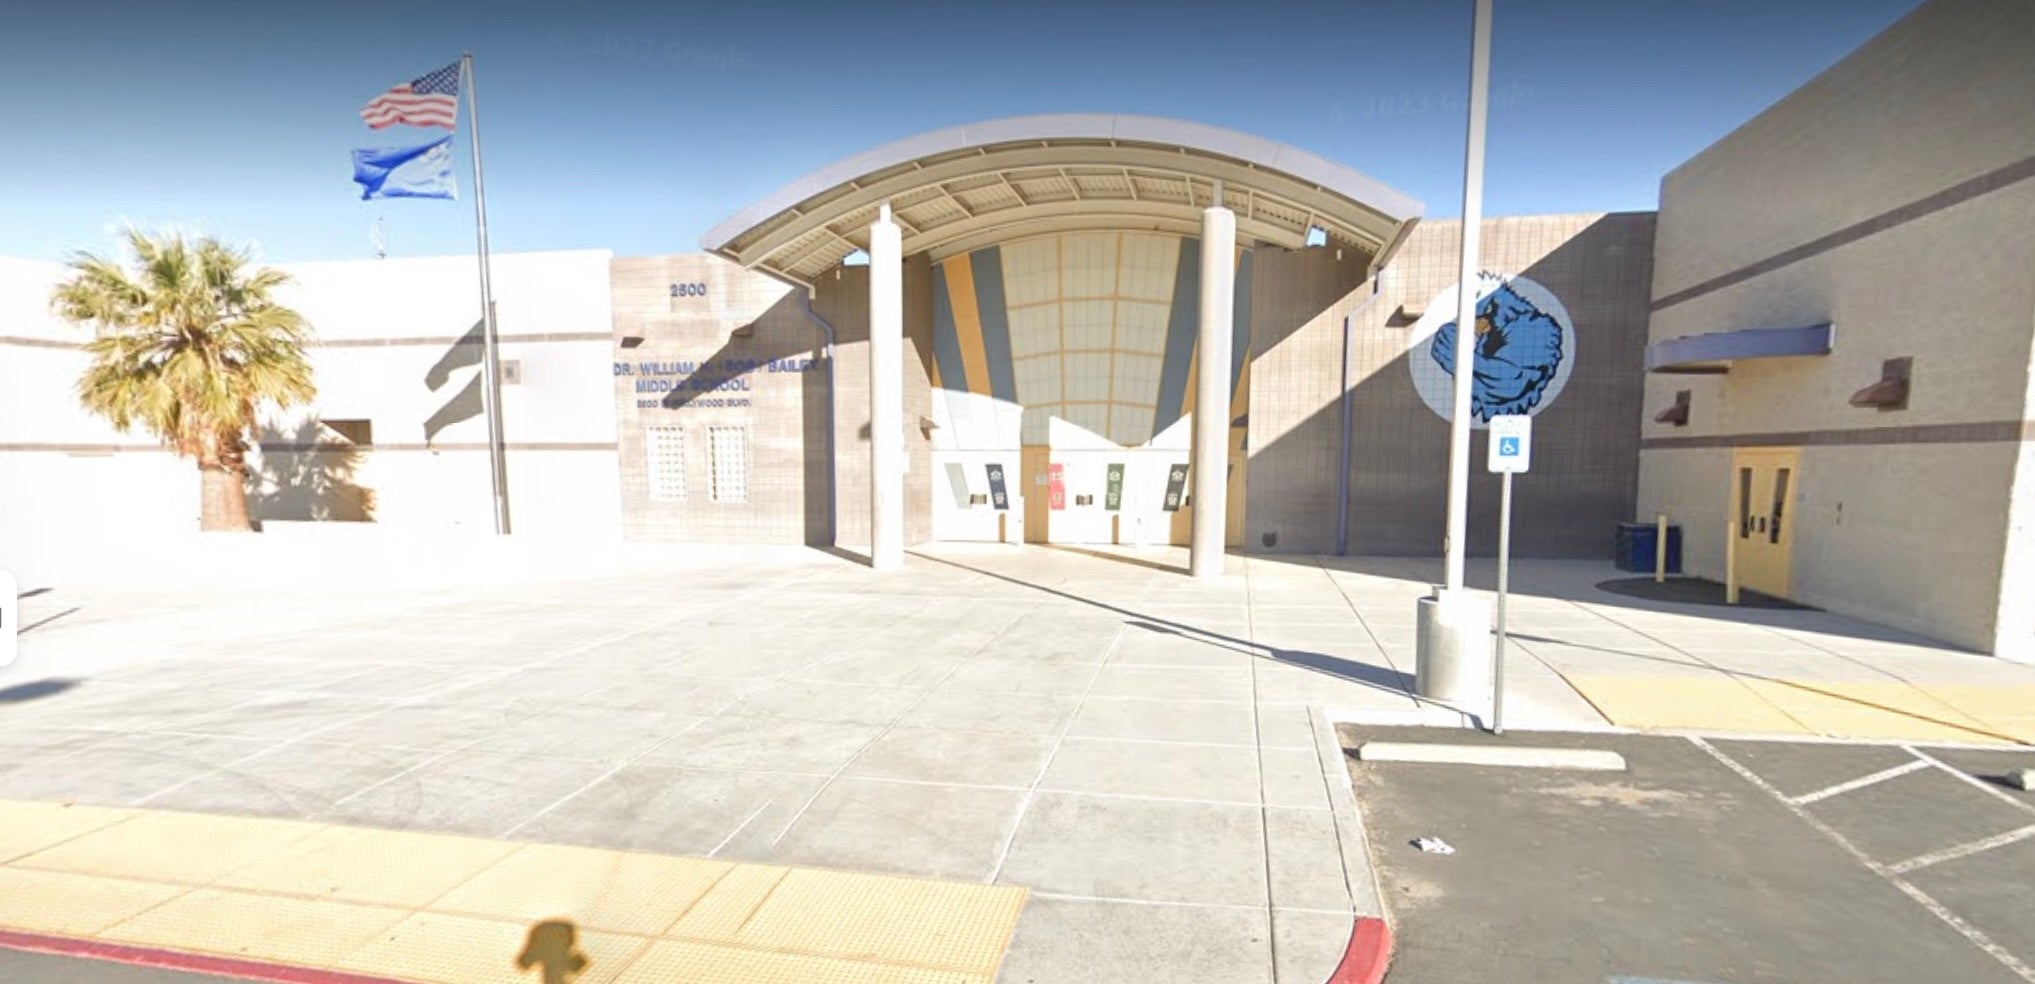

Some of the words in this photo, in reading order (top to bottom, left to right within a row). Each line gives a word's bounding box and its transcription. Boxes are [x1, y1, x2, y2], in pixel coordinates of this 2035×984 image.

[670, 283, 707, 297] 2500
[613, 362, 634, 377] DR.
[639, 361, 694, 376] WILLIAM
[768, 358, 818, 373] BAILEY
[635, 380, 686, 393] MIDDLE
